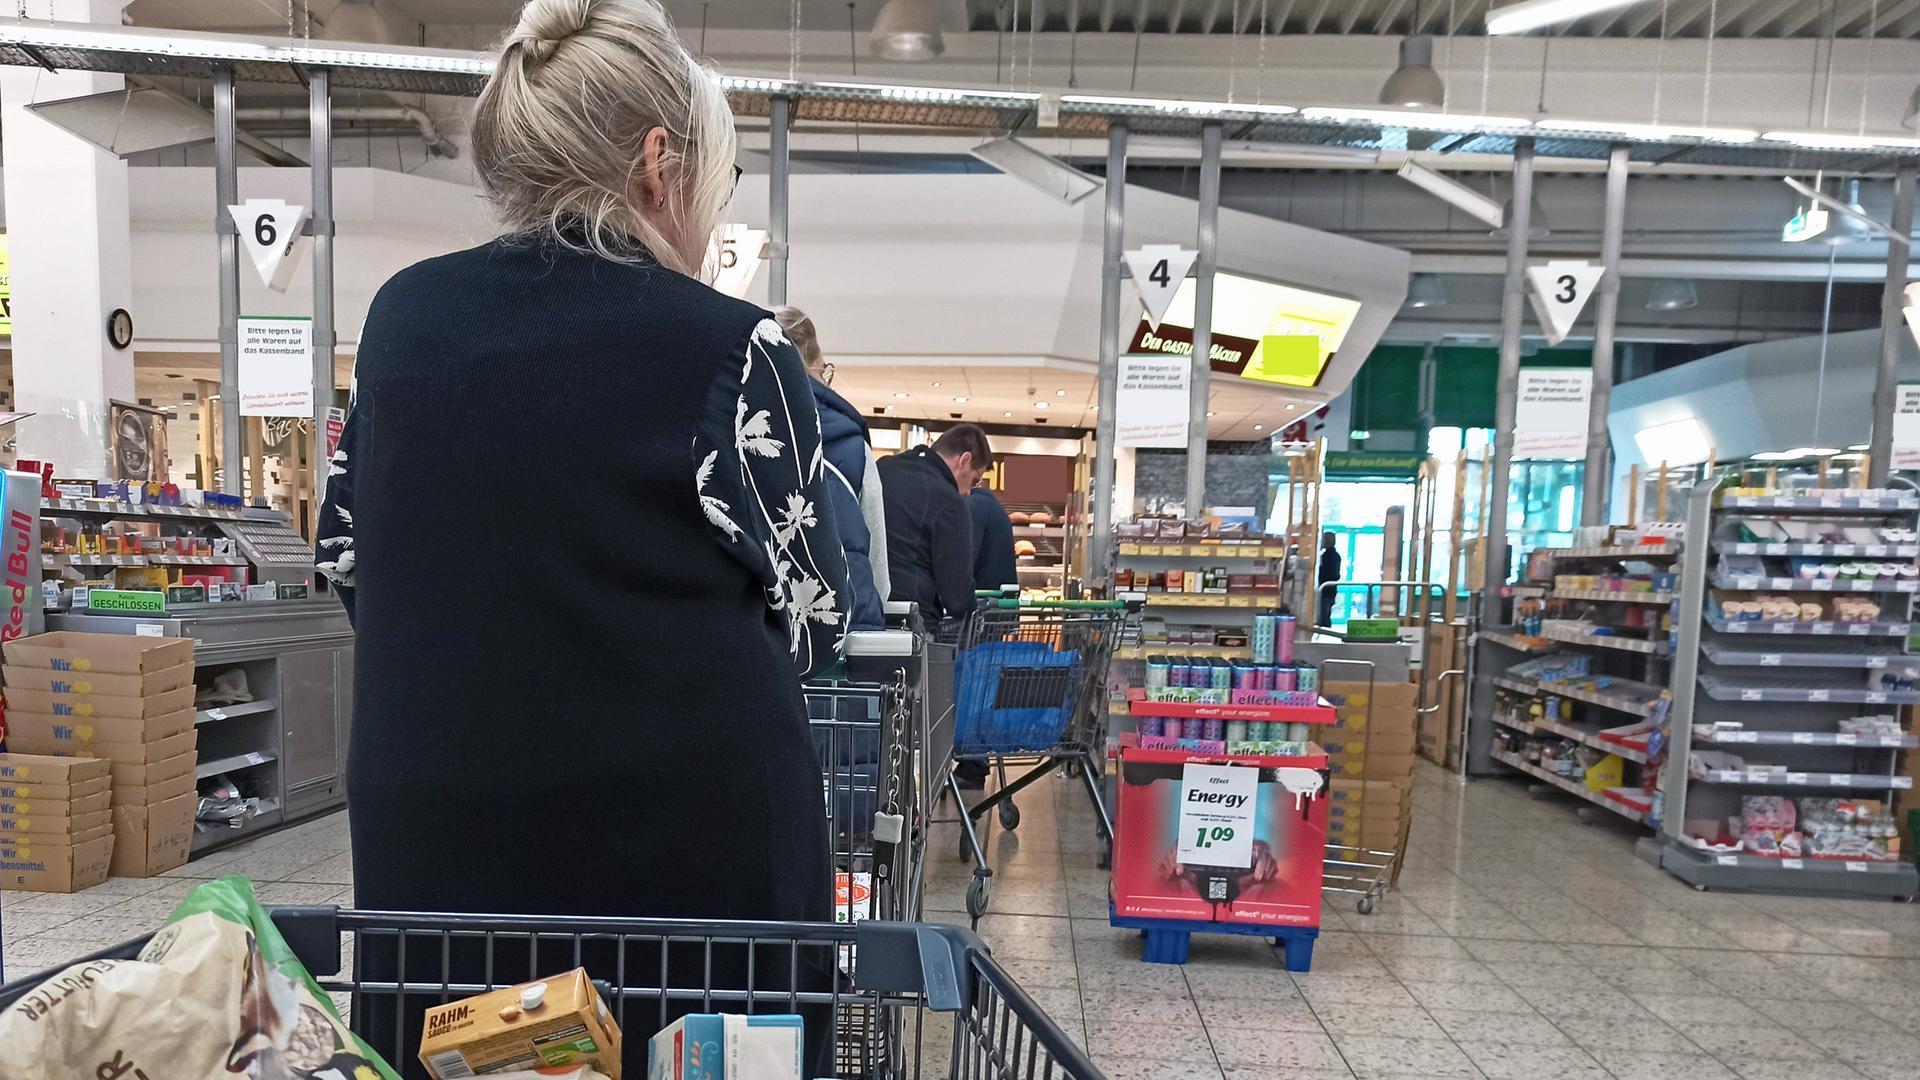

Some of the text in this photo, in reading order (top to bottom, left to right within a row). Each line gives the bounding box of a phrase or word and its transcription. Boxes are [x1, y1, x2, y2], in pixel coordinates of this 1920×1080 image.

[254, 213, 277, 247] 6
[720, 239, 738, 269] 5
[1148, 259, 1171, 289] 4
[1555, 274, 1577, 304] 3
[1, 509, 32, 642] Red Bull
[93, 599, 162, 611] GESCHLOSSEN
[50, 657, 71, 671] Wir
[50, 680, 71, 693] Wir
[1158, 694, 1192, 704] effect
[1238, 695, 1278, 706] effect
[51, 702, 72, 716] Wir
[51, 725, 72, 739] Wir
[0, 766, 16, 777] Wir
[1209, 777, 1230, 785] Effect
[1, 786, 16, 797] Wir
[1187, 788, 1249, 809] Energy
[1, 804, 16, 814] Wir
[2, 820, 17, 829] Wir
[1195, 826, 1235, 849] 1.09
[2, 848, 17, 859] Wir
[429, 1004, 476, 1030] RAHM-
